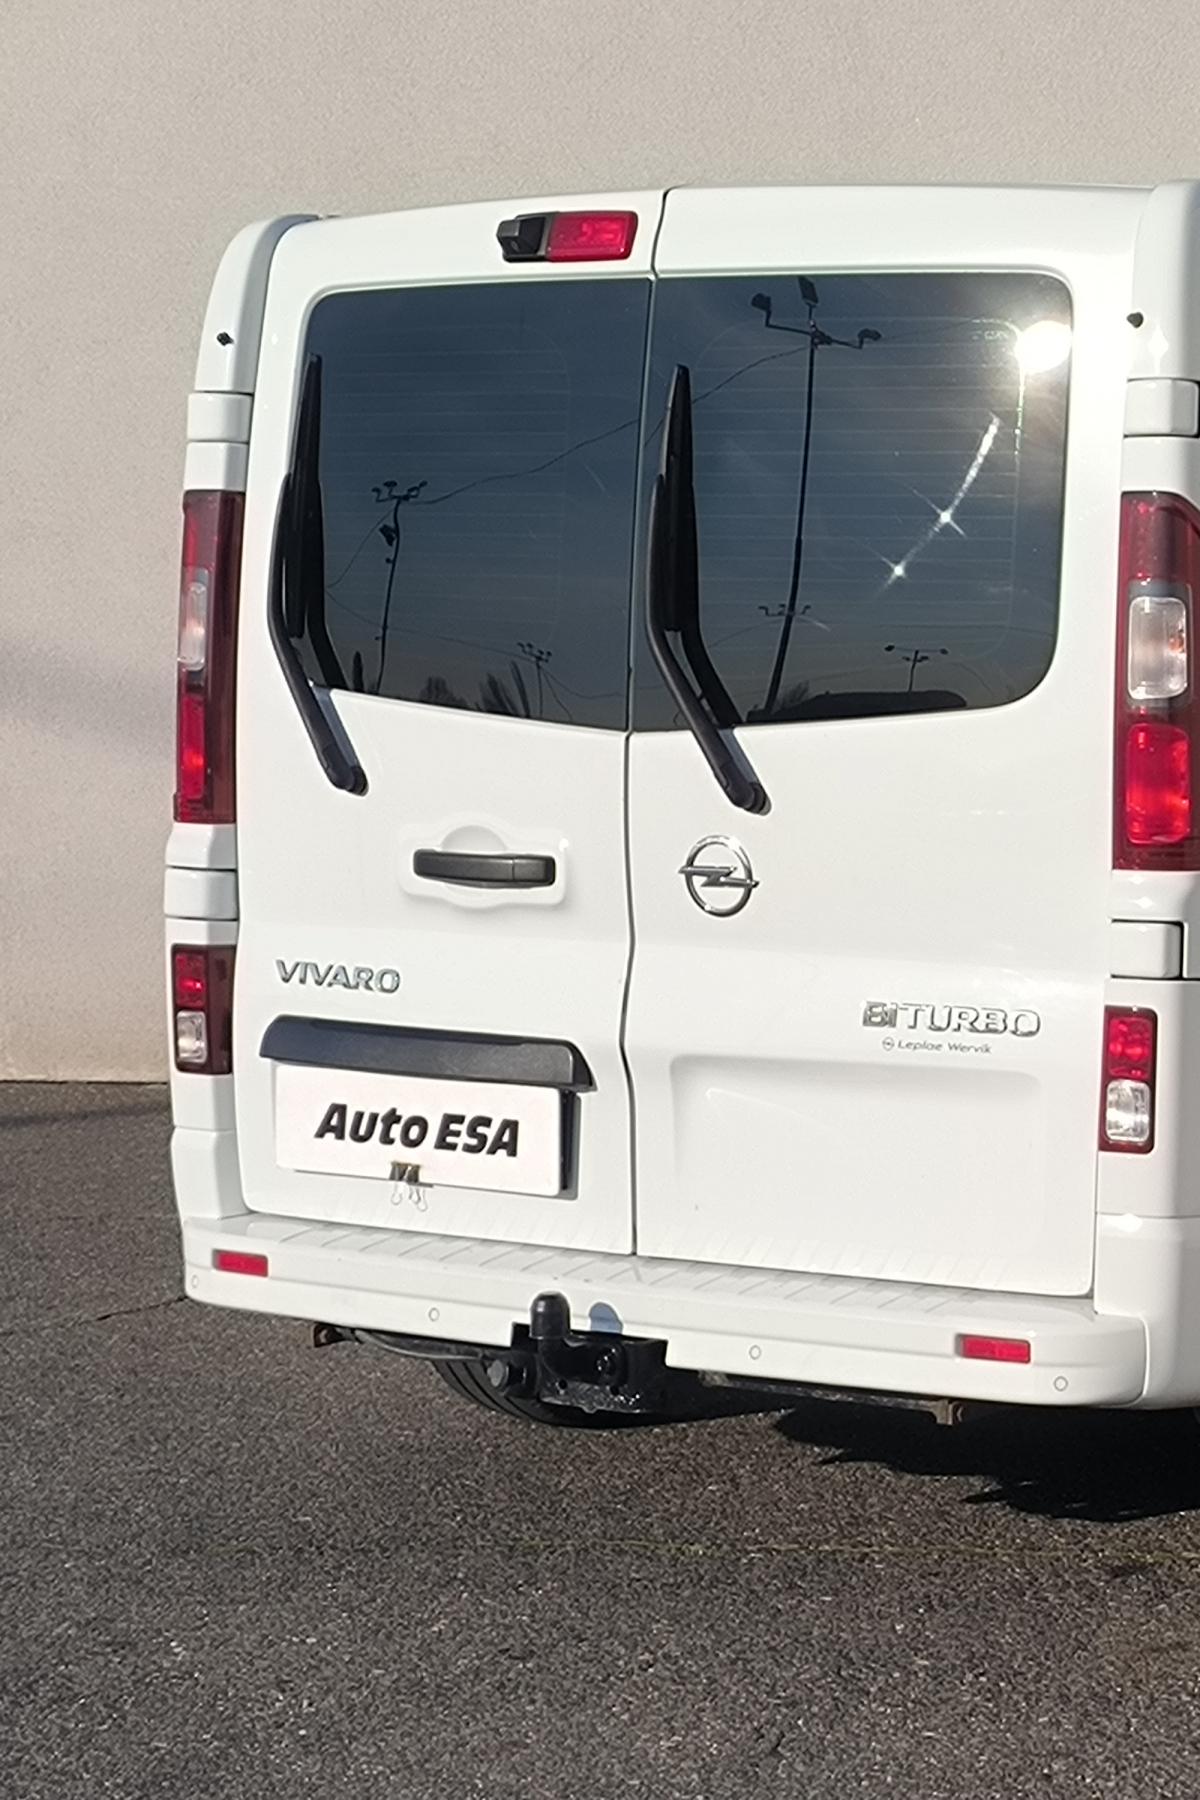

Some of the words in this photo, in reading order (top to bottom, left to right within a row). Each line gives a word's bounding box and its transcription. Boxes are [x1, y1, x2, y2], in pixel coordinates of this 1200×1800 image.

[276, 959, 401, 994] VIVARO
[948, 1042, 992, 1054] Wervik
[314, 1102, 429, 1149] Auto
[434, 1113, 519, 1158] ESA
